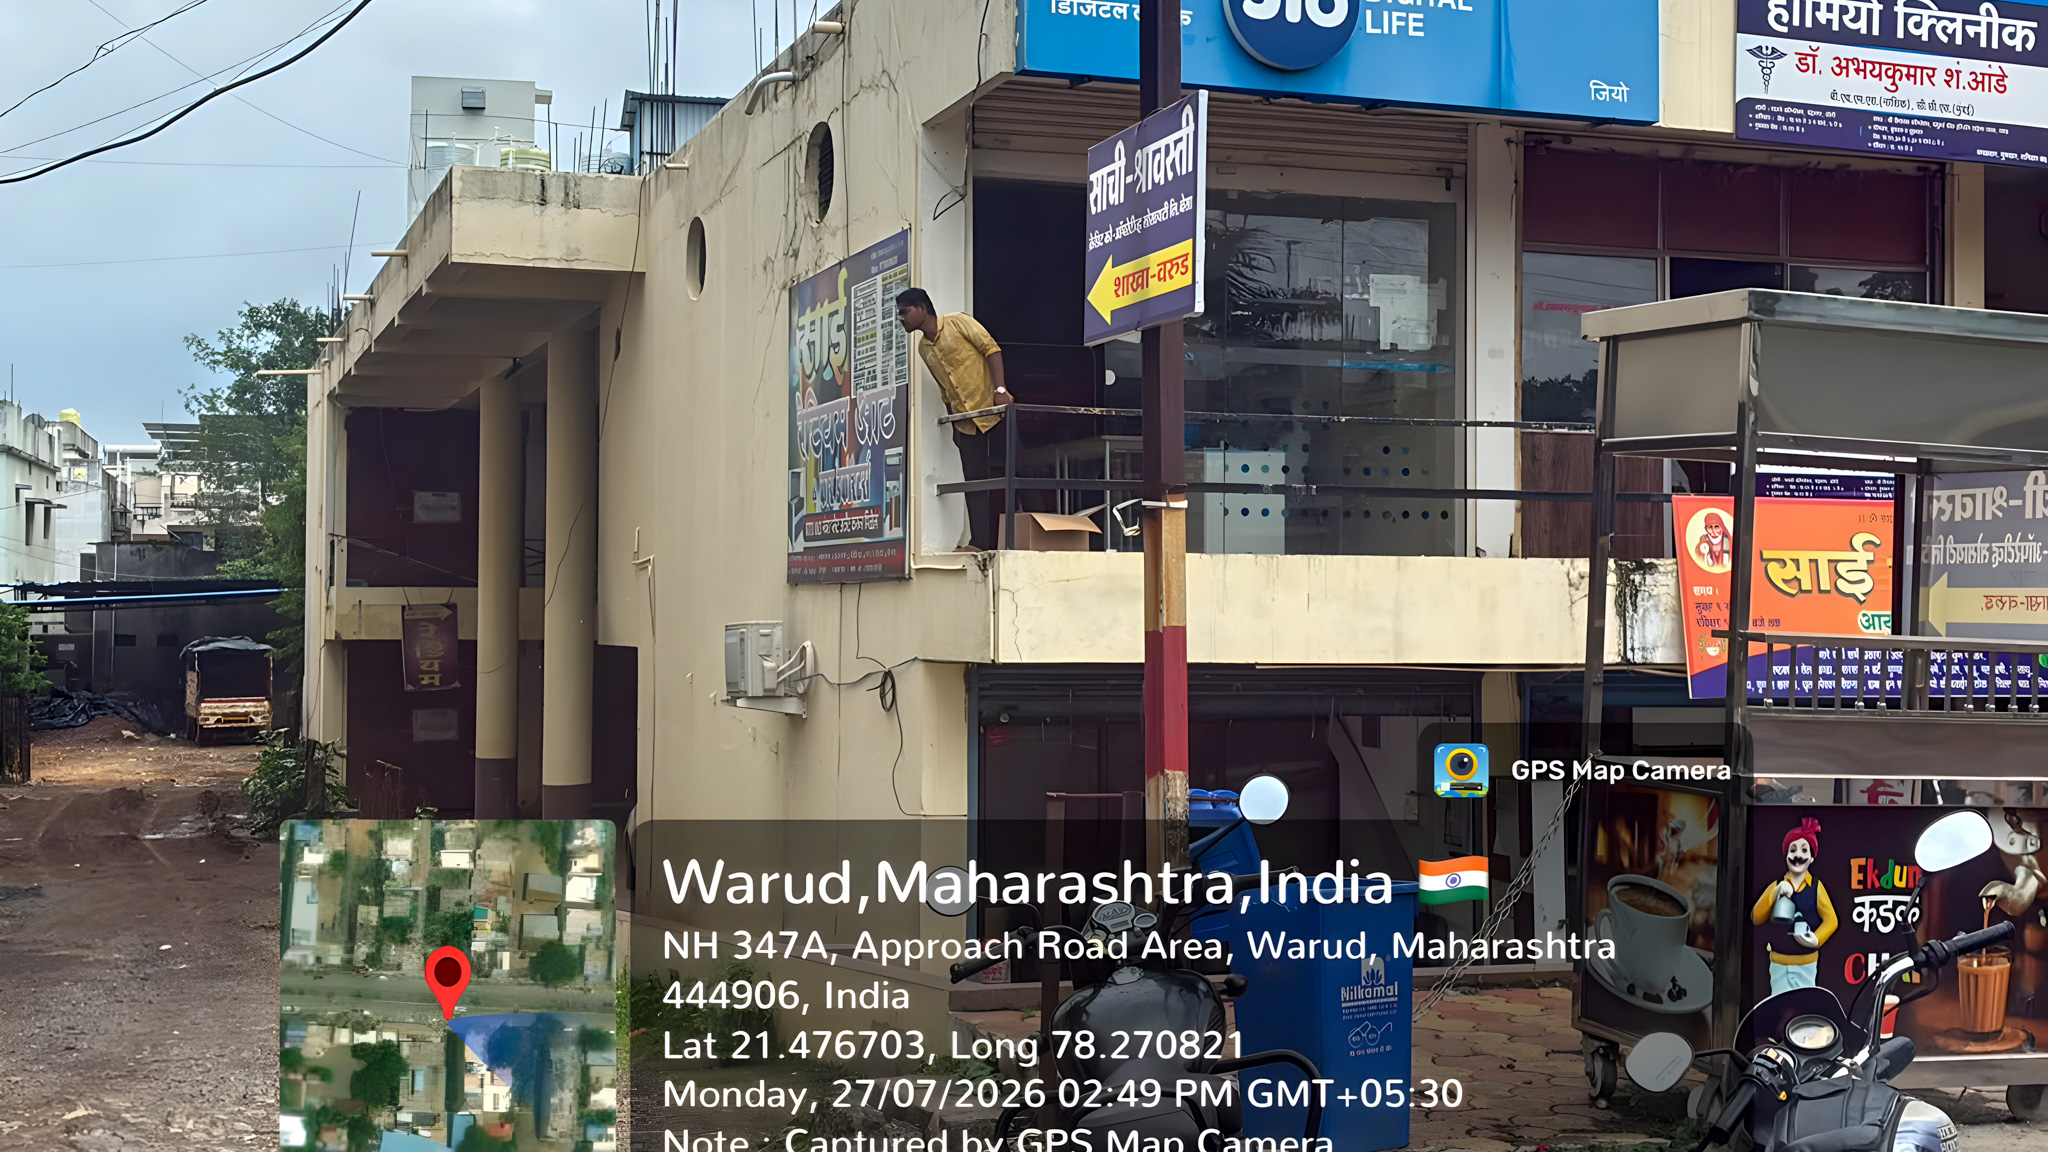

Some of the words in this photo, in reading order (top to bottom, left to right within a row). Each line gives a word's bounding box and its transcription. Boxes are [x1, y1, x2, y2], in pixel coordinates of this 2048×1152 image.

[1365, 9, 1425, 37] LIFE
[1794, 45, 1823, 76] डॉ.
[1831, 55, 1938, 93] अभयकुमार
[1589, 79, 1630, 103] जियो
[1113, 252, 1190, 298] शाखा-वरुड
[1760, 531, 1882, 604] साई
[1341, 981, 1399, 1002] Nilkamal
